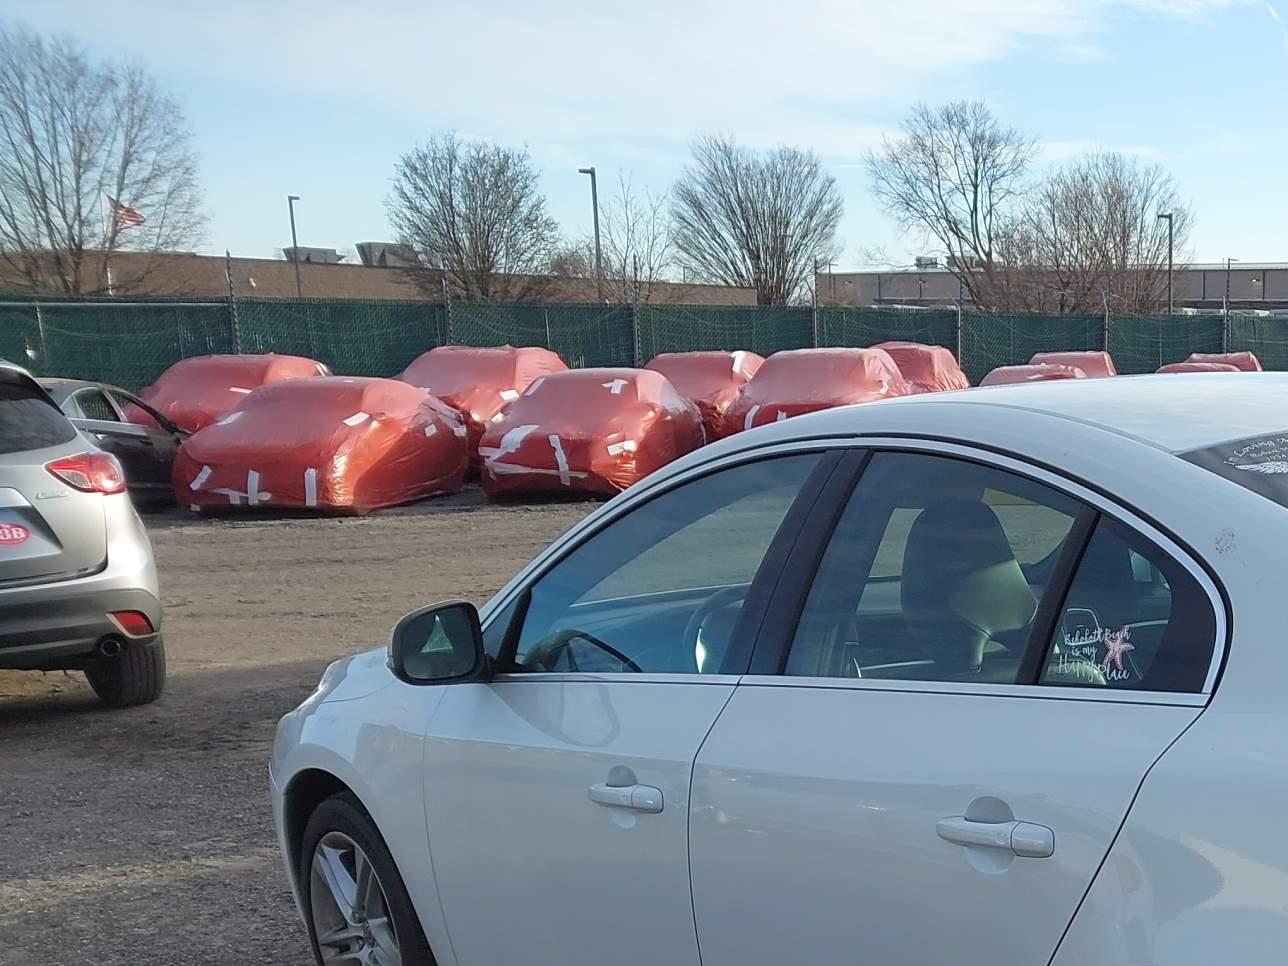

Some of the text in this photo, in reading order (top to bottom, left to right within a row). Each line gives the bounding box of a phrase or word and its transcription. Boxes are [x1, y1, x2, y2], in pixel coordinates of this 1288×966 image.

[1234, 441, 1275, 456] Loving
[1071, 645, 1098, 664] is my
[1058, 653, 1097, 682] Happy
